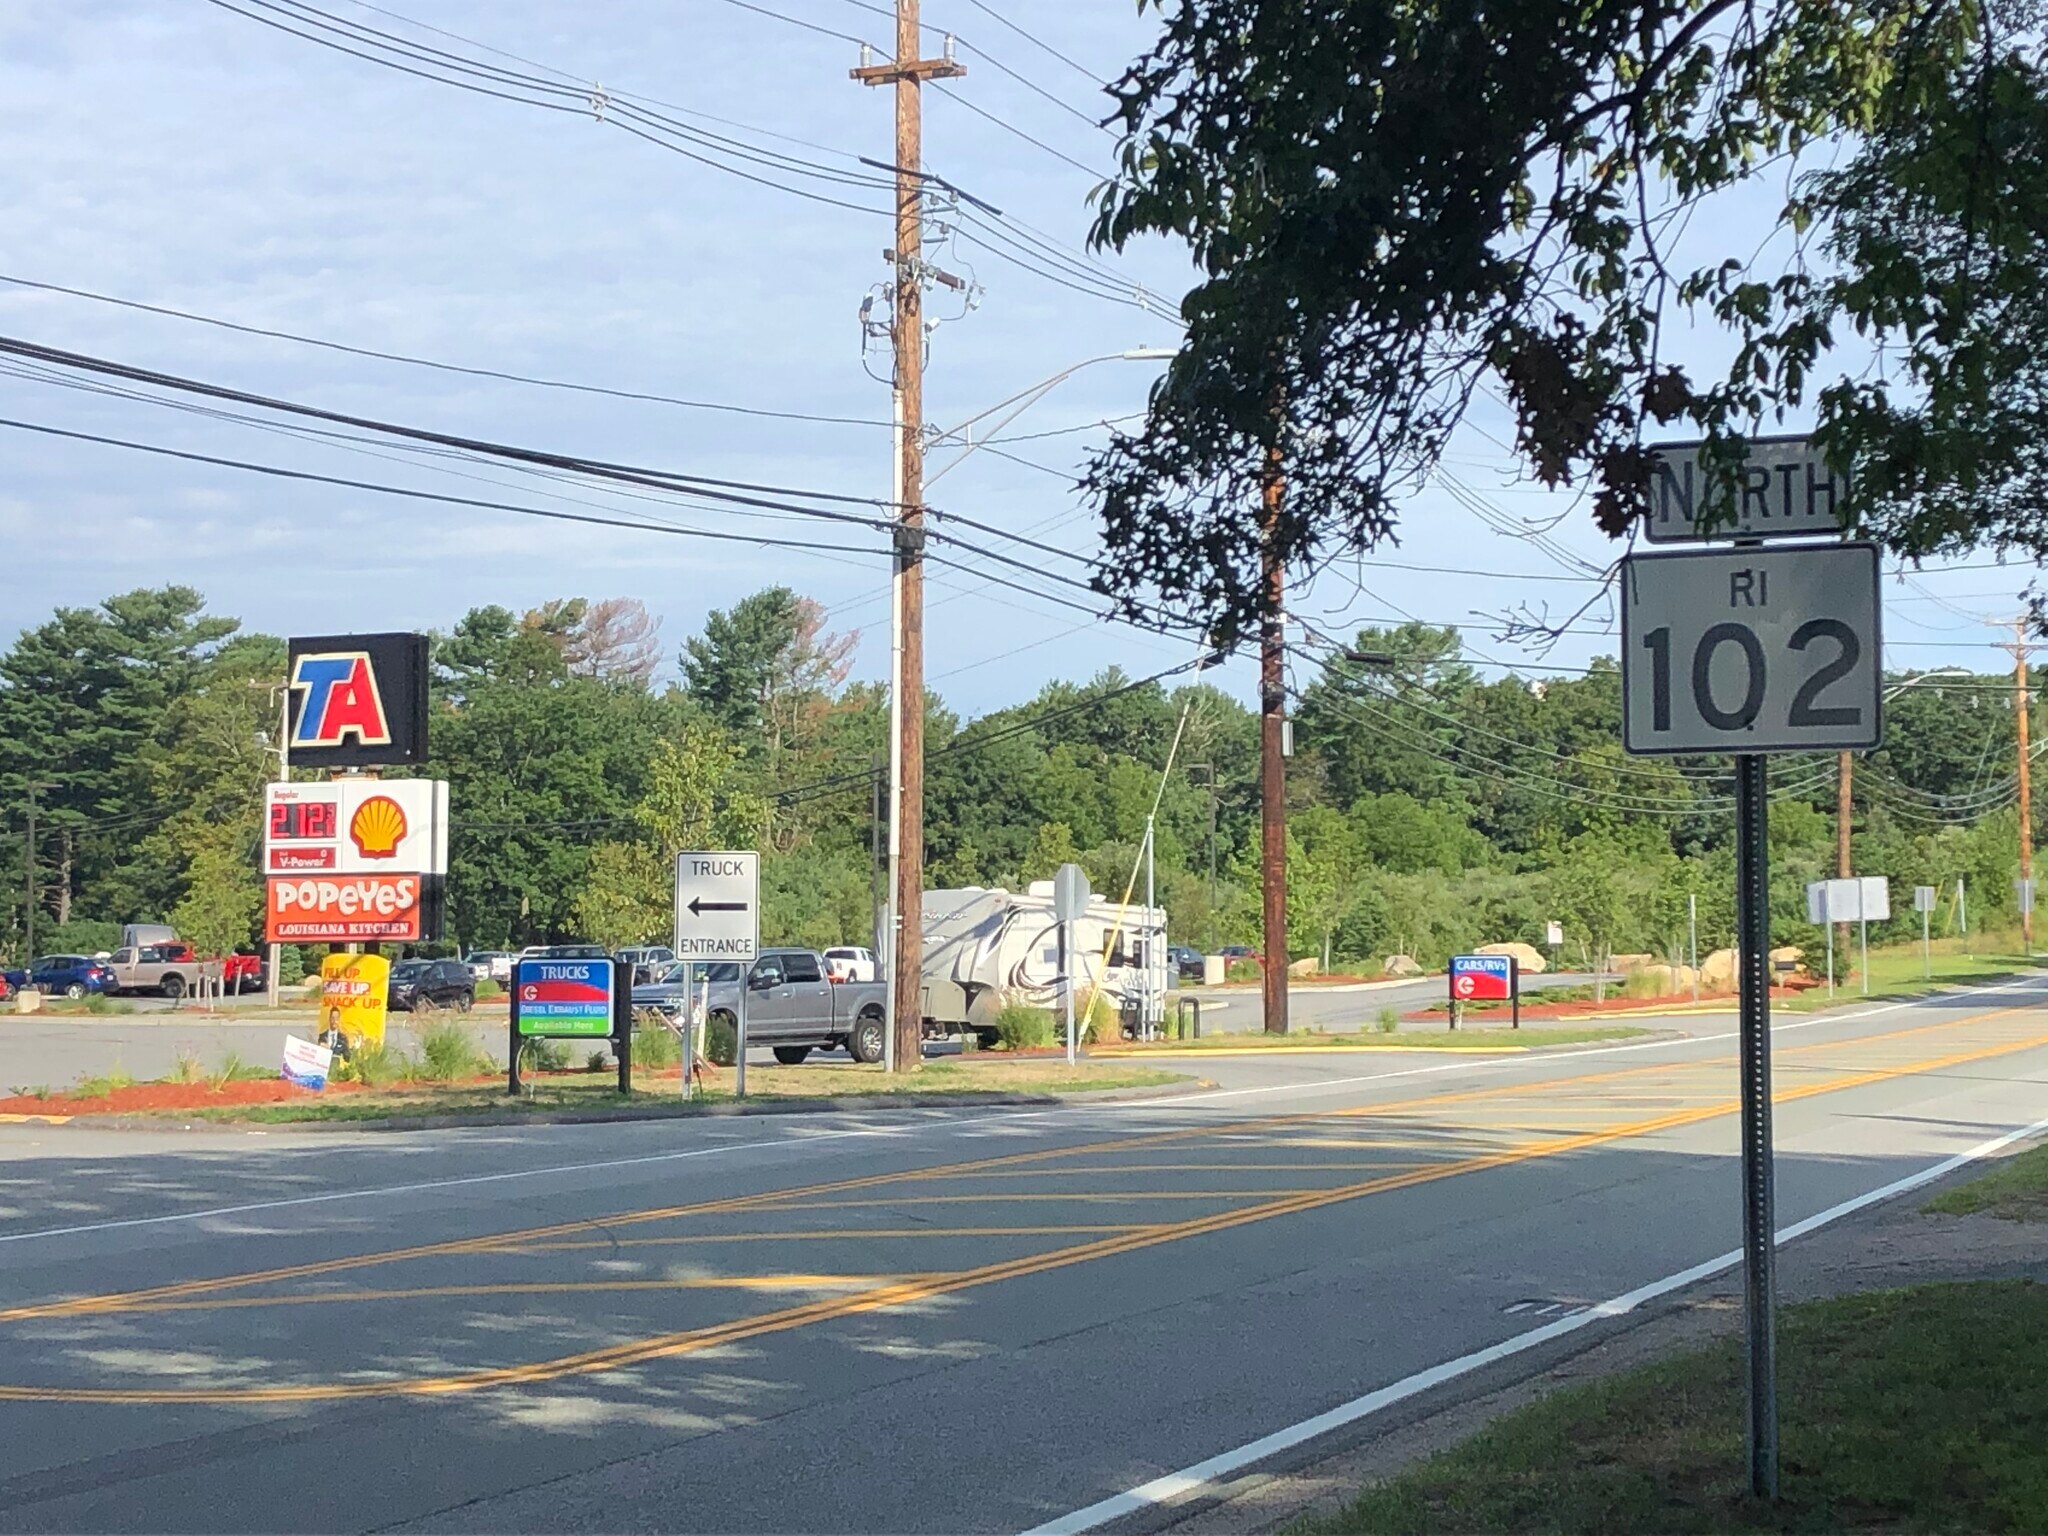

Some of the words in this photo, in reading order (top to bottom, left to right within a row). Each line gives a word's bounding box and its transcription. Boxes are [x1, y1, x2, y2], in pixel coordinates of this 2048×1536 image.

[1730, 569, 1767, 607] RI
[1643, 618, 1861, 732] 102
[290, 651, 391, 748] TA
[280, 856, 326, 867] V-Power
[692, 860, 744, 876] TRUCK
[279, 923, 345, 935] LOUISIANA
[349, 922, 409, 934] KITCHEN
[681, 938, 752, 953] ENTRANCE
[541, 966, 590, 979] TRUCKS
[323, 981, 348, 994] SAVE
[323, 996, 357, 1008] SNACK
